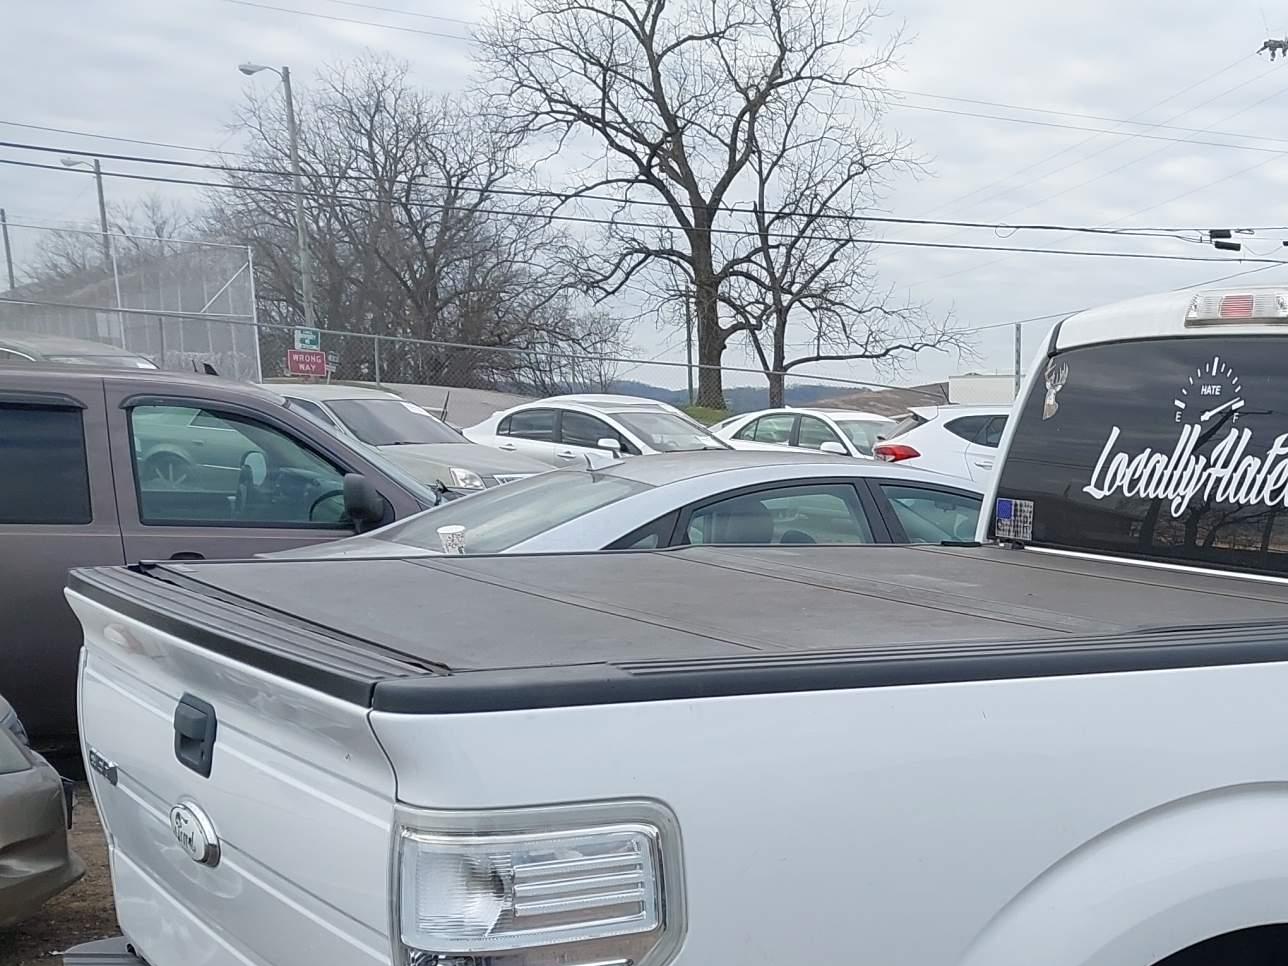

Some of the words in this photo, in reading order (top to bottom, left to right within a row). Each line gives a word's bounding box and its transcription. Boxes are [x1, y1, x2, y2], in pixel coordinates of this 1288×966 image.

[292, 353, 322, 363] WRONG
[299, 363, 317, 372] WAY
[1200, 384, 1221, 396] HATE
[1175, 411, 1182, 422] E
[1232, 412, 1239, 423] F
